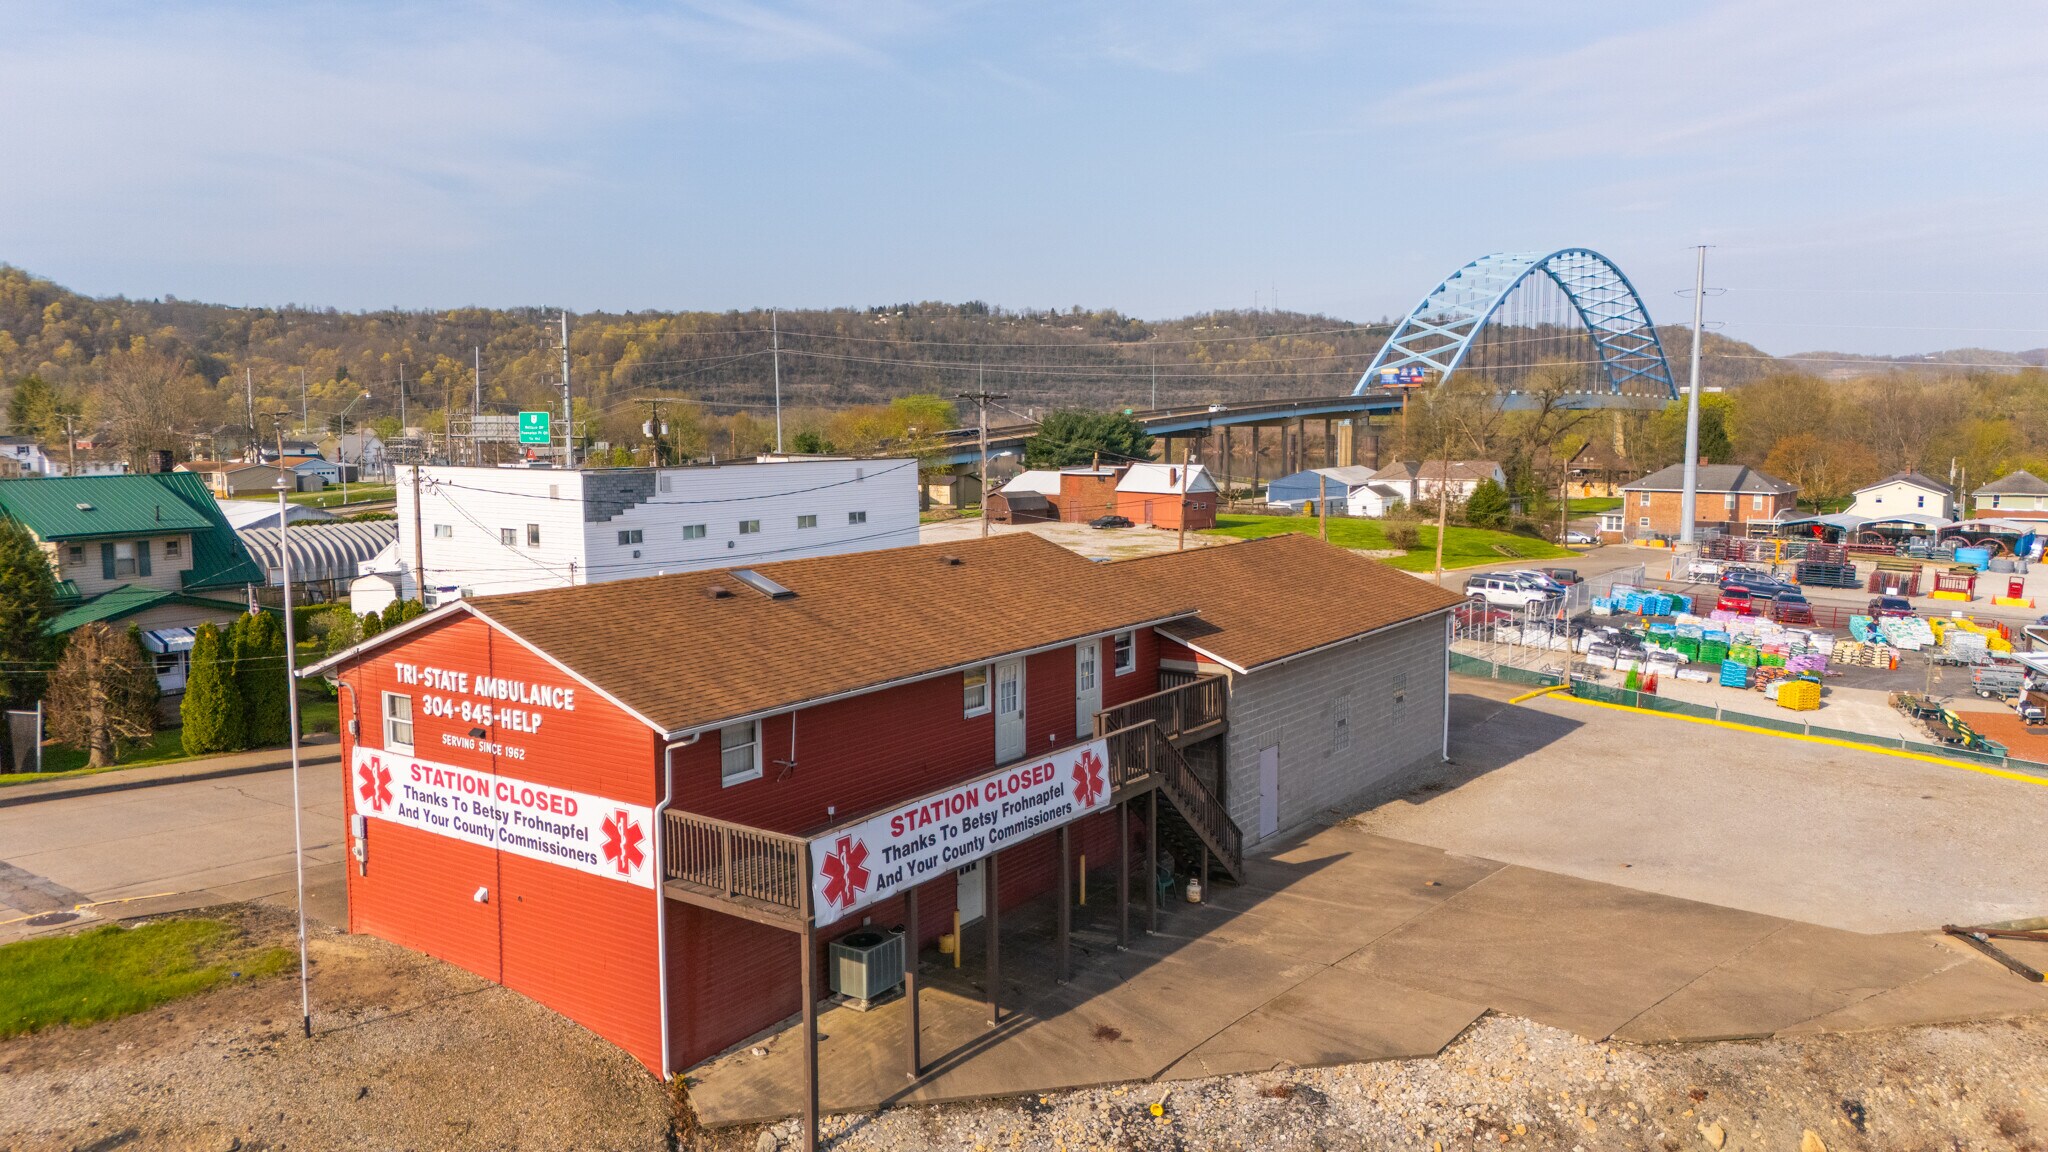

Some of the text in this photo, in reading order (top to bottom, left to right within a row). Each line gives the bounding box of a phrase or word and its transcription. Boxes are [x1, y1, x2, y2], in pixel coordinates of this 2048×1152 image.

[395, 663, 575, 711] TRI-STATE AMBULANCE
[422, 695, 542, 734] 304-845-HELP
[442, 734, 525, 760] SERVING SINCE 1962
[403, 785, 589, 842] Thanks To Betsy Frohnapfel
[410, 764, 578, 817] STATION CLOSED
[890, 762, 1055, 838] STATION CLOSED
[398, 803, 598, 865] And Your County Commissioners
[876, 802, 1072, 892] And Your County Commissioners
[882, 782, 1064, 864] Thanks To Betsy Frohnapfel
